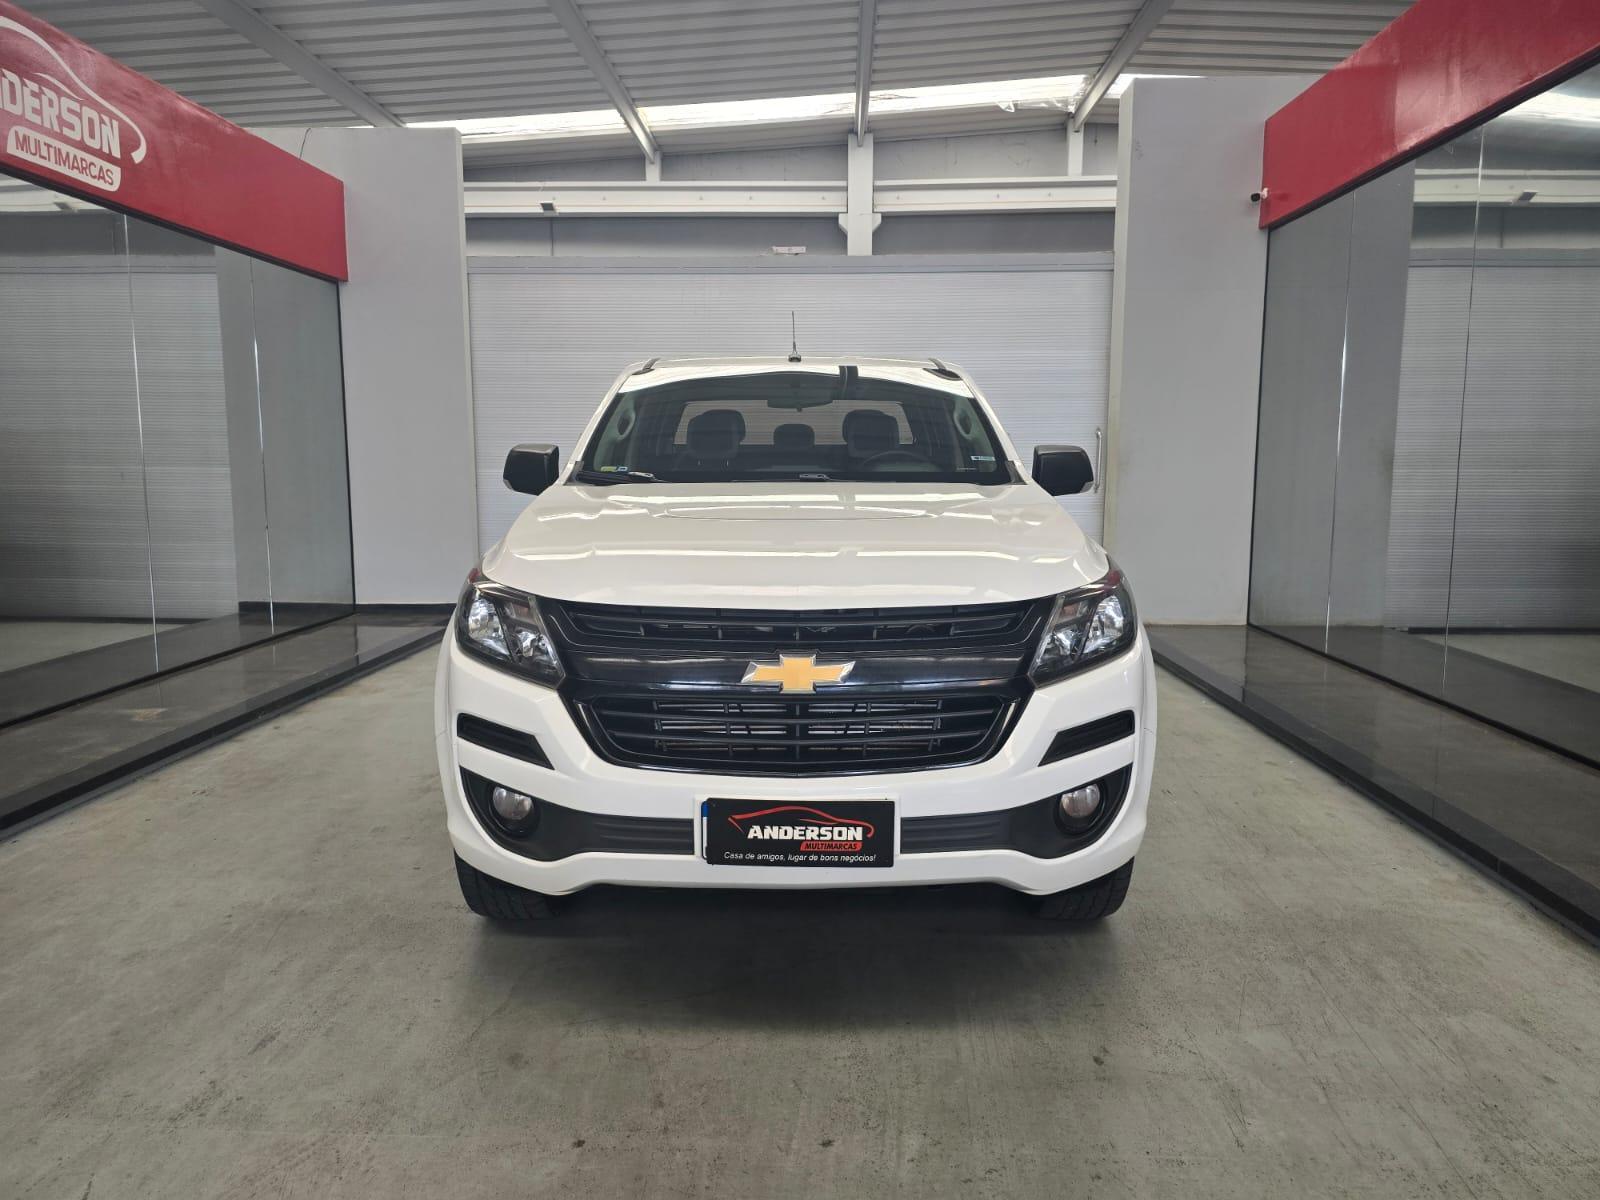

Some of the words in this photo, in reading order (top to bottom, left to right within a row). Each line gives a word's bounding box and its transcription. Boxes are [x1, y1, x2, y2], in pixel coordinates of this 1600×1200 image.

[0, 68, 121, 159] DERSON
[14, 130, 115, 186] MULTIMARCAS
[747, 825, 863, 840] ANDERSON
[804, 841, 858, 850] MULTIMARCAS
[723, 851, 744, 859] Casa
[745, 852, 755, 860] de
[757, 853, 786, 862] amigos,
[787, 853, 807, 862] lugar
[808, 853, 819, 861] de
